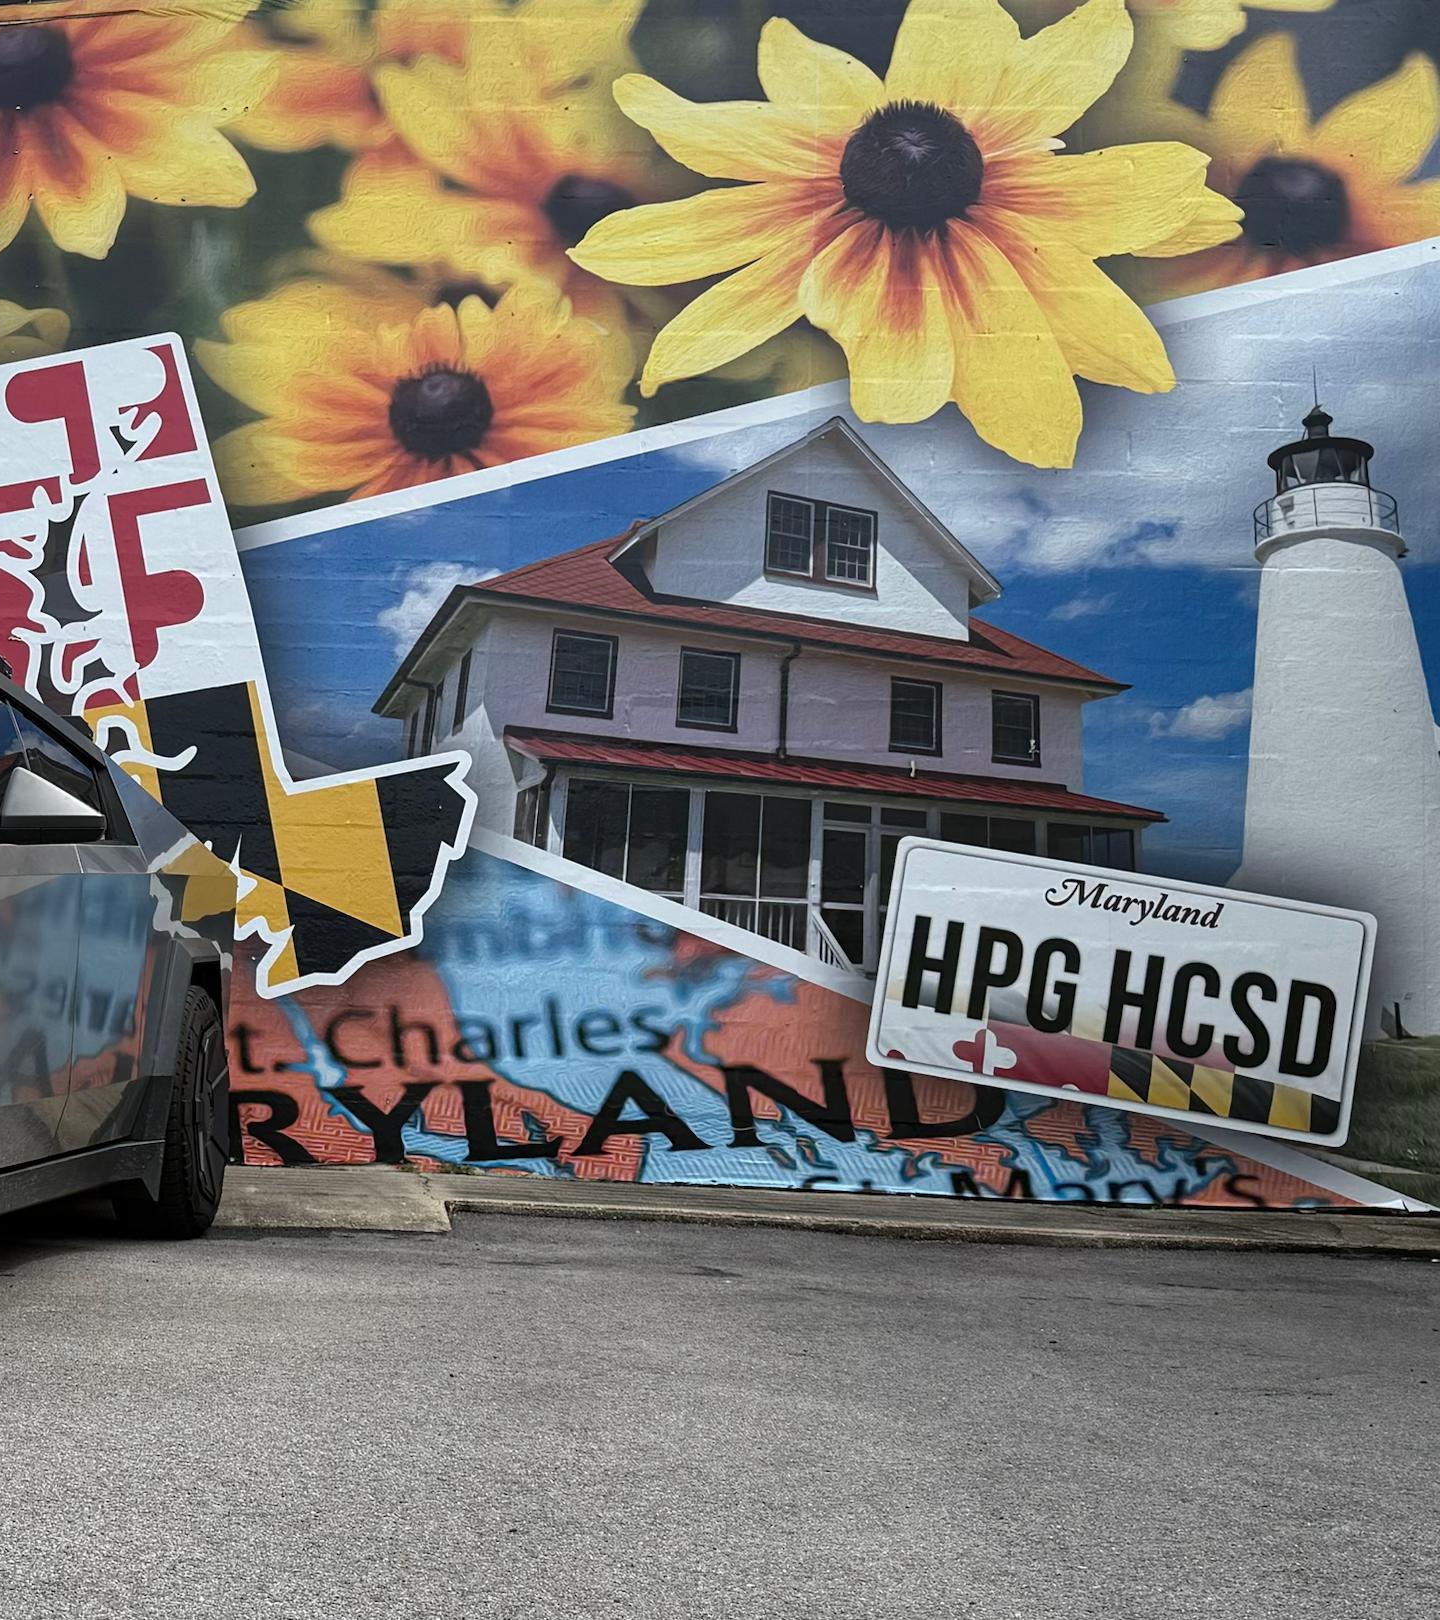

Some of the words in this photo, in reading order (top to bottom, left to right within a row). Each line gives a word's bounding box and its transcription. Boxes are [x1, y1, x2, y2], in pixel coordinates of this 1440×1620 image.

[1045, 878, 1224, 929] Maryland
[231, 1023, 296, 1073] t.
[325, 998, 669, 1070] Charles
[901, 915, 1081, 1034] HPG
[1103, 949, 1337, 1078] HCSD
[229, 1058, 1006, 1165] RYLAND
